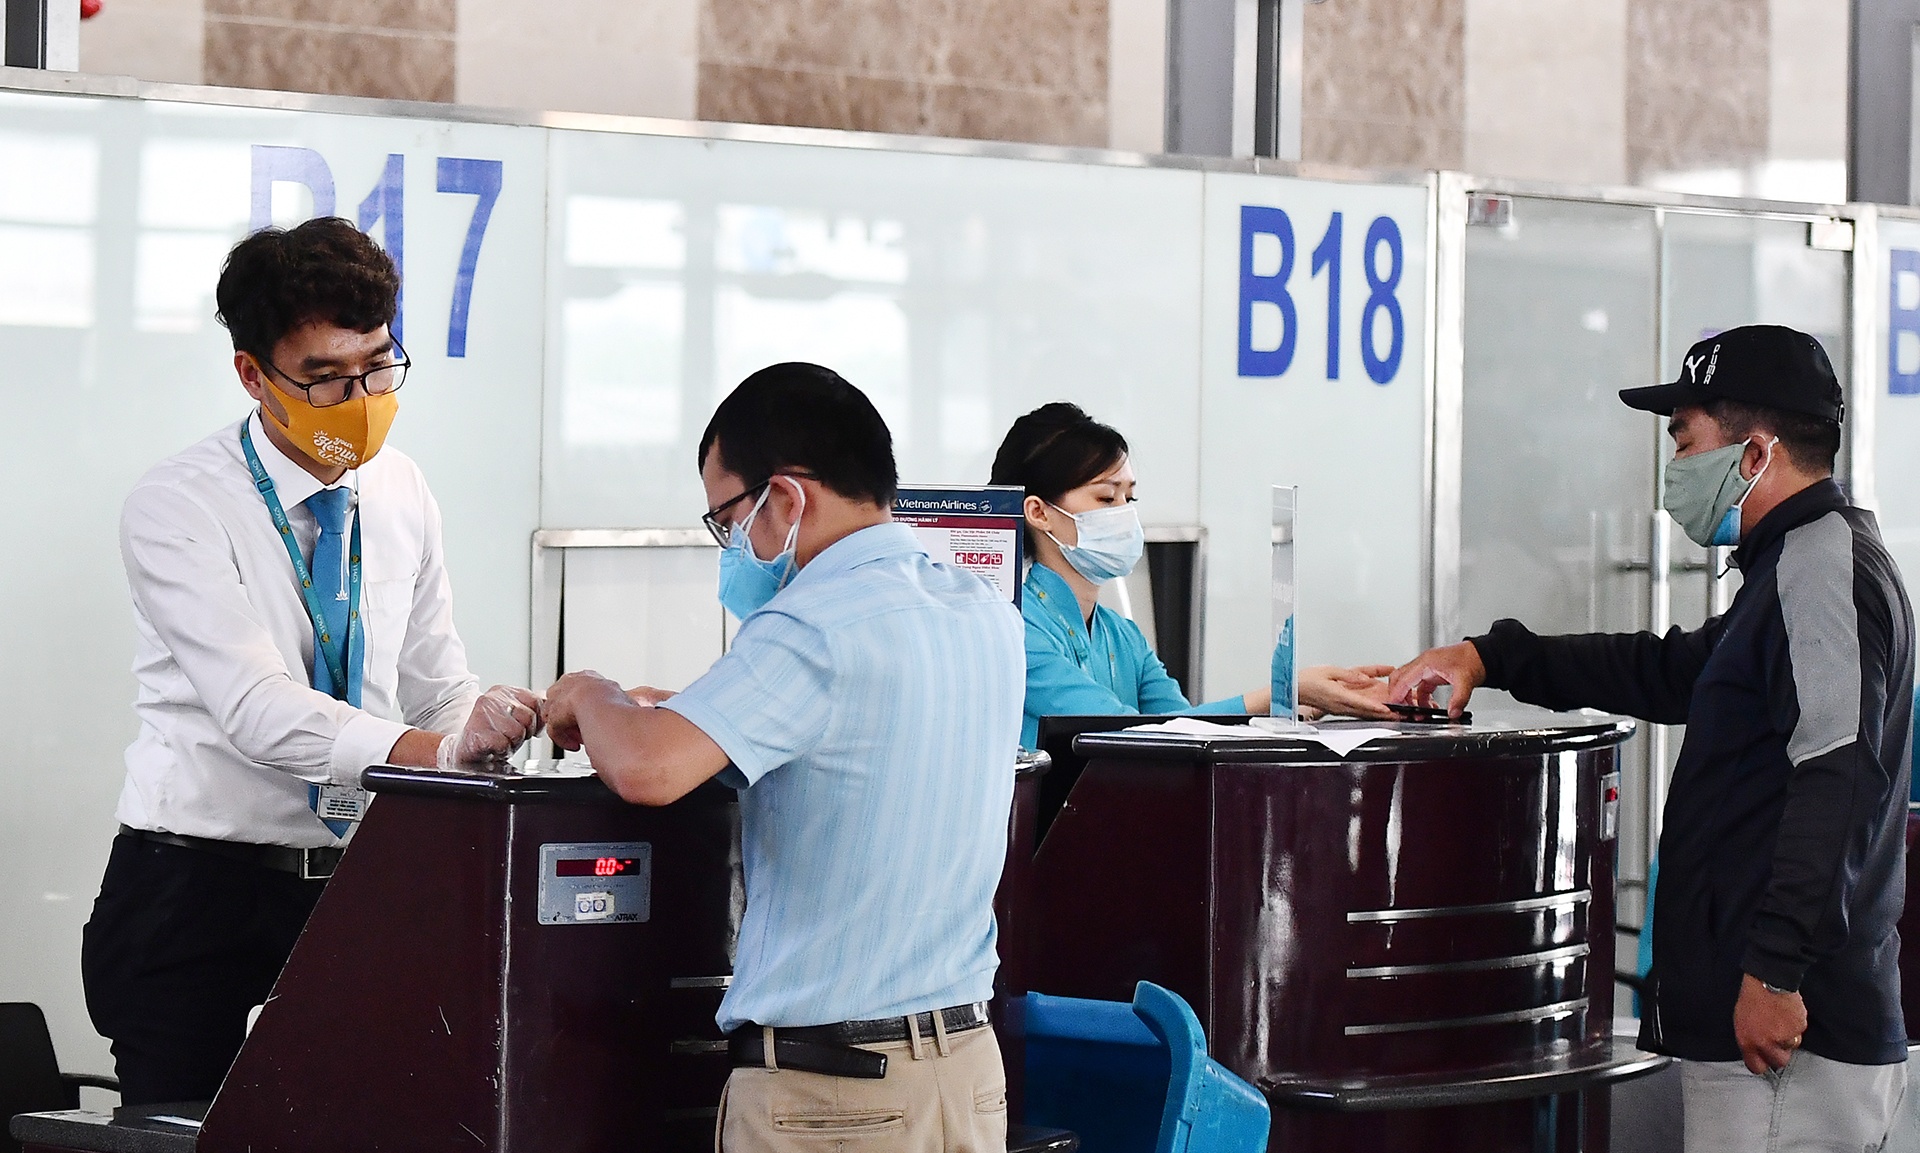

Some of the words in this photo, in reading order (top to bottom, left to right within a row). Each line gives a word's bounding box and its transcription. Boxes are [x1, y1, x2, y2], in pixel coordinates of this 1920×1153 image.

[1237, 205, 1405, 385] B18
[1703, 344, 1721, 385] PUMA
[898, 499, 940, 509] Vietnam
[940, 500, 977, 510] Airlines
